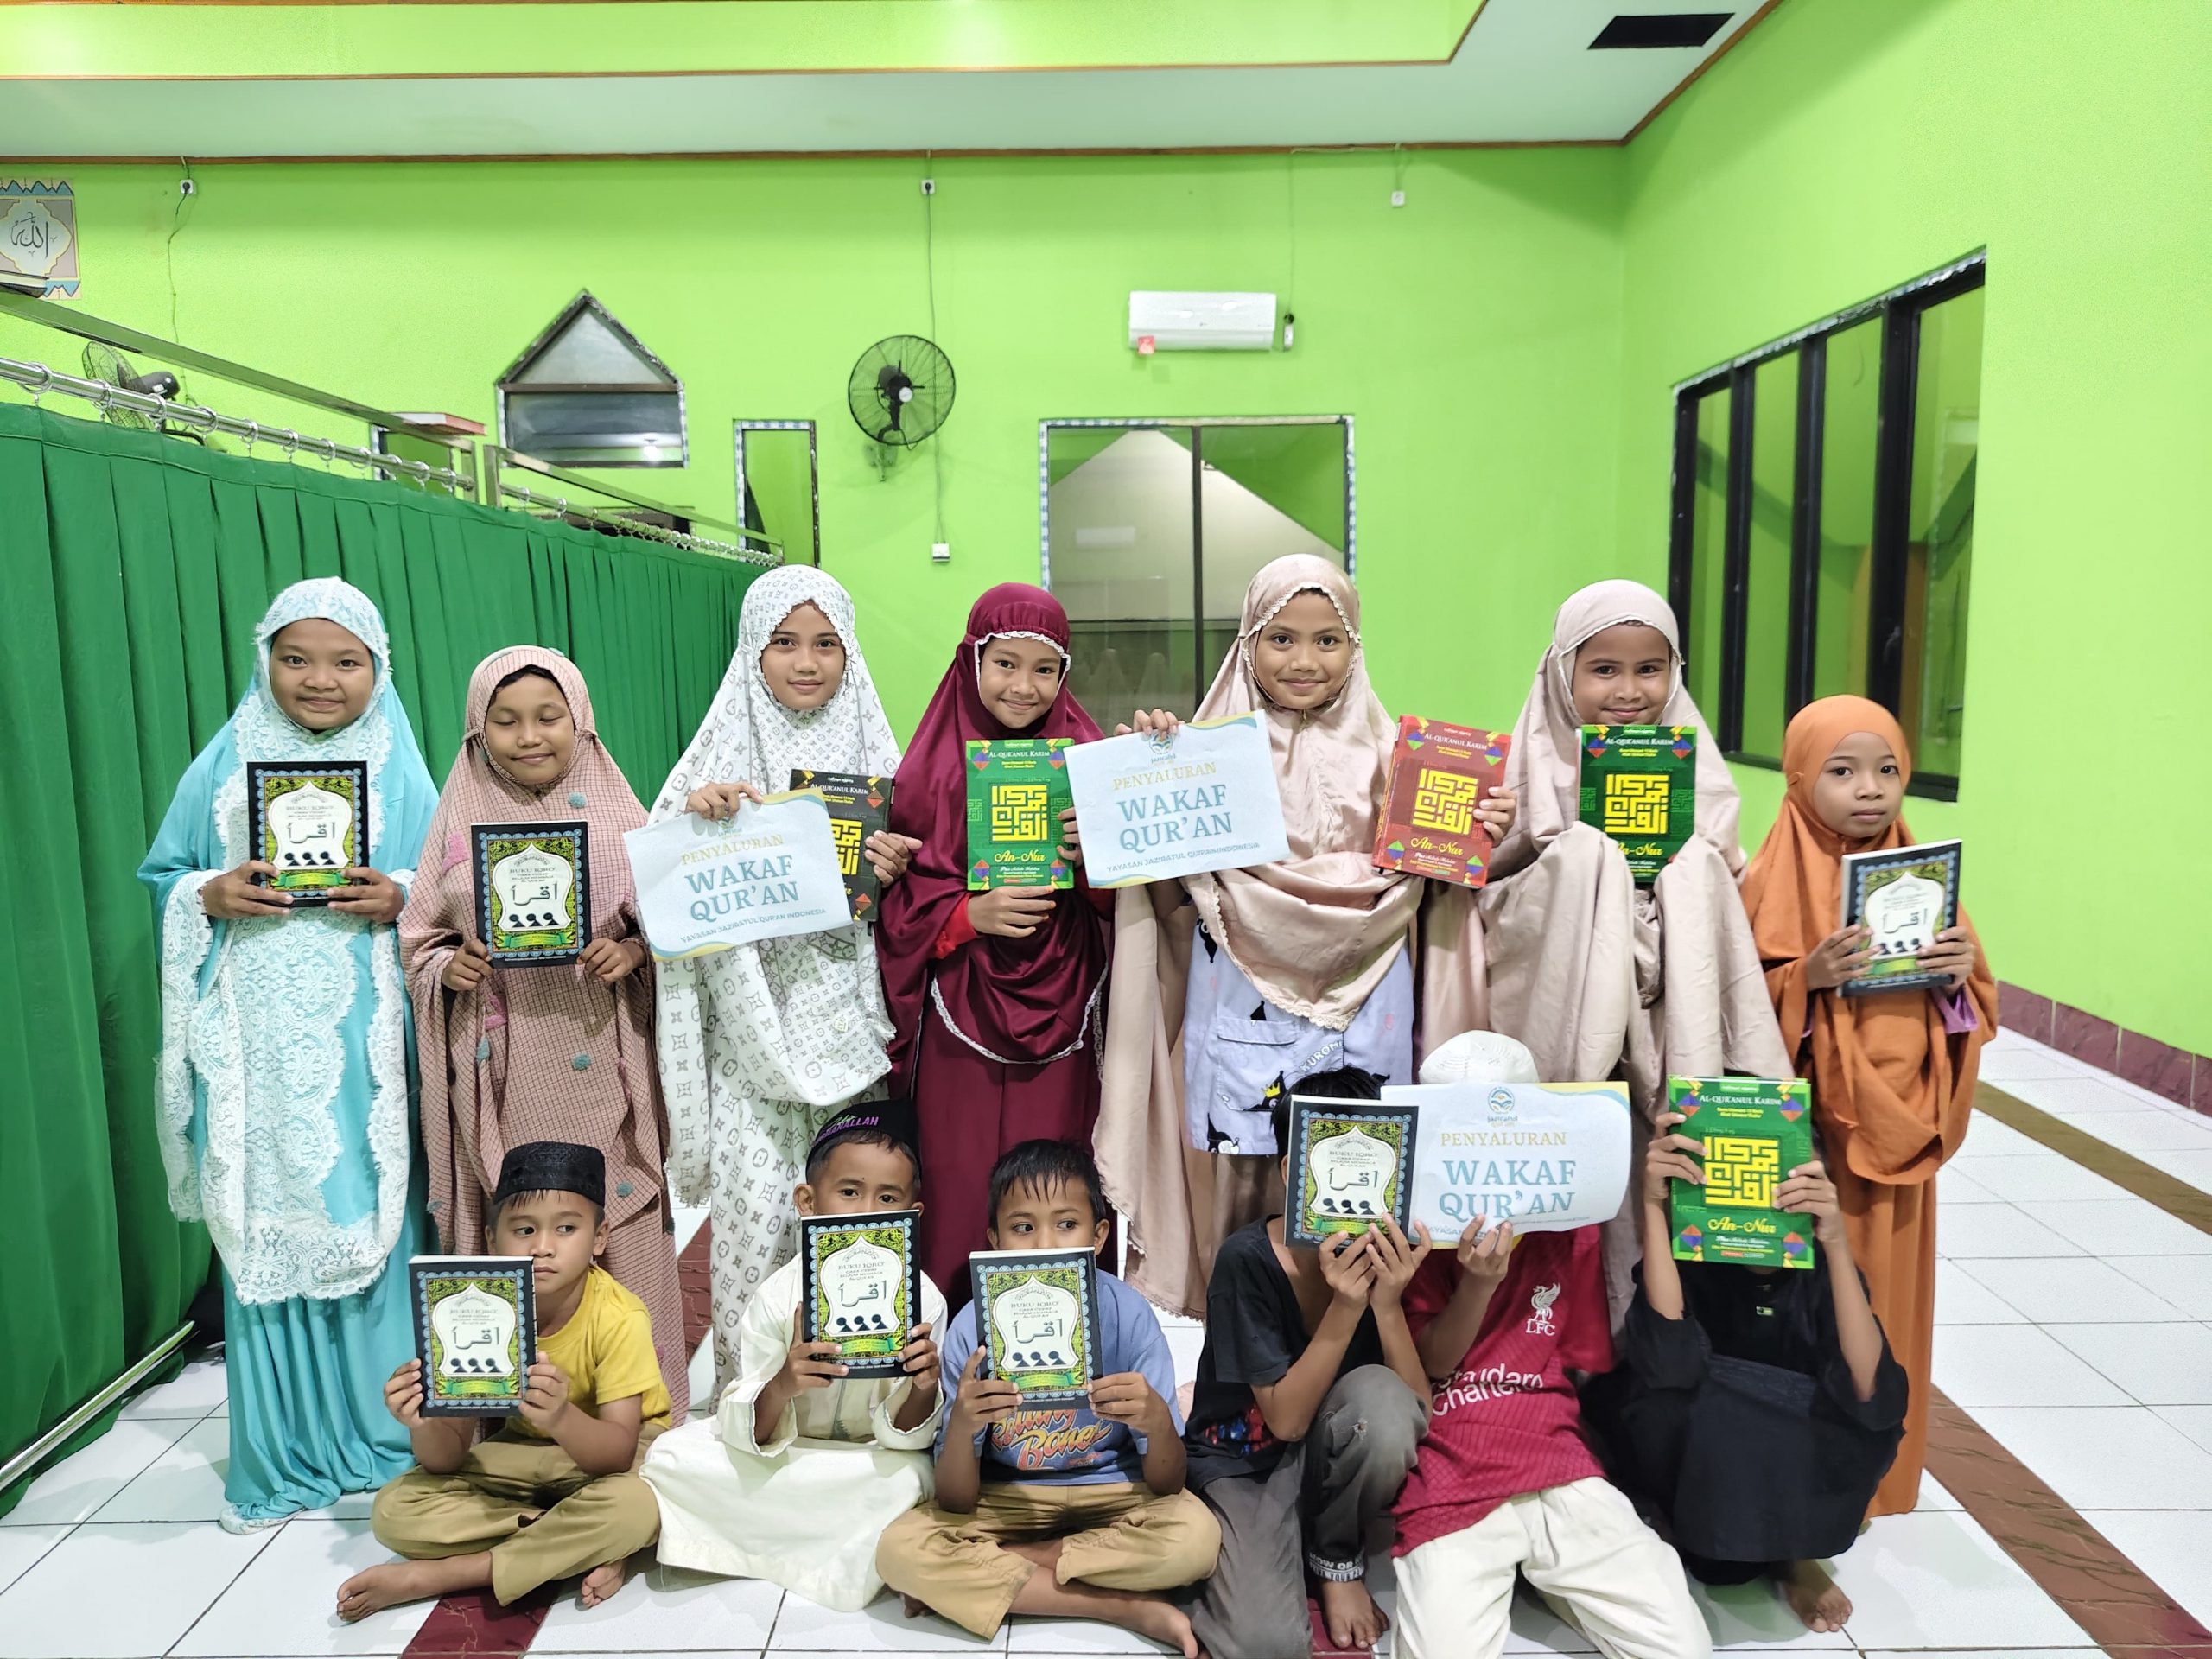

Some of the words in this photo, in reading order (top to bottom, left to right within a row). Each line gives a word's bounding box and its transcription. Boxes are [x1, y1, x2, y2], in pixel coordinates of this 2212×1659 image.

[1113, 761, 1217, 791] PENYALURAN
[1116, 784, 1227, 822] WAKAF
[1120, 812, 1233, 854] QUR'AN
[1411, 836, 1463, 855] An-Nur
[681, 834, 784, 866] PENYALURAN
[995, 849, 1046, 863] An-Nur
[1107, 861, 1143, 873] YAYASAN
[1145, 853, 1186, 866] JAZIRATUL
[1217, 842, 1260, 854] INDONESIA
[684, 855, 793, 894] WAKAF
[690, 881, 799, 923] QUR'AN
[680, 928, 717, 944] YAYASAN
[718, 918, 759, 933] JAZIRATUL
[787, 908, 827, 919] INDONESIA
[1440, 1131, 1567, 1147] PENYALURAN
[1442, 1160, 1577, 1186] WAKAF
[1439, 1190, 1577, 1224] QUR'AN
[1707, 1216, 1777, 1234] An-Nur
[1526, 1318, 1556, 1337] LFC
